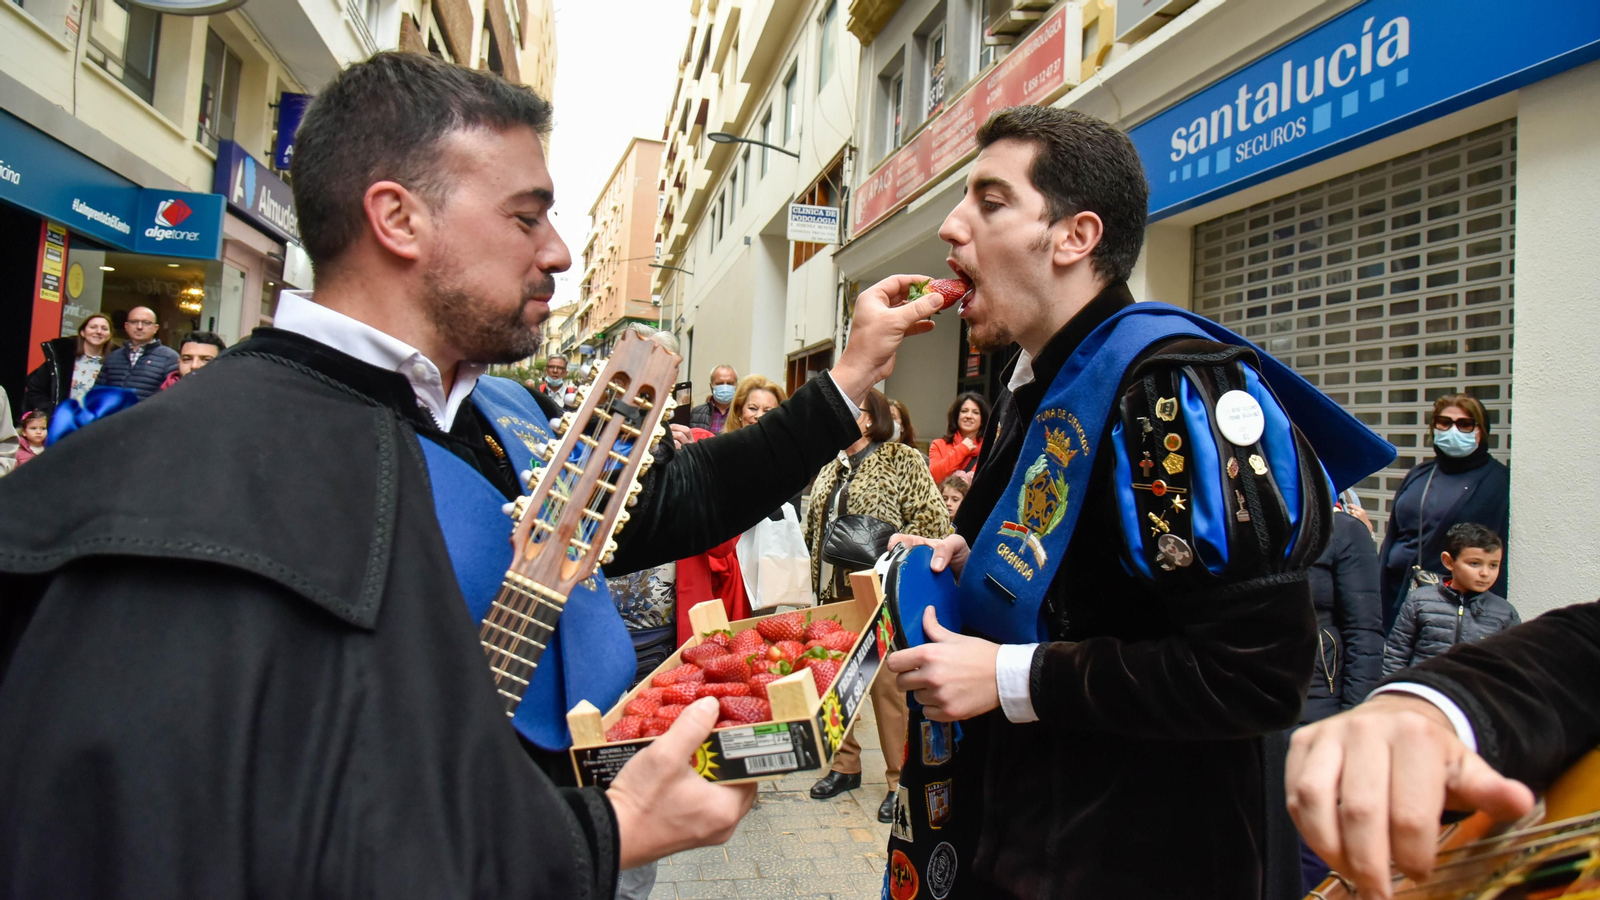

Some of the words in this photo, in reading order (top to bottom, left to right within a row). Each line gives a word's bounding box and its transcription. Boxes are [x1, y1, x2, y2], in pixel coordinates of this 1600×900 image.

[1169, 15, 1411, 162] santalucía
[1235, 116, 1306, 164] SEGUROS
[0, 159, 21, 185] icina
[258, 185, 301, 237] Almuden
[792, 207, 824, 216] CLINICA
[792, 215, 836, 225] PODOLOGIA
[1035, 408, 1056, 423] TUNA
[1057, 408, 1066, 420] DE
[1067, 413, 1090, 457] CIENCIAS
[997, 542, 1034, 582] GRANADA
